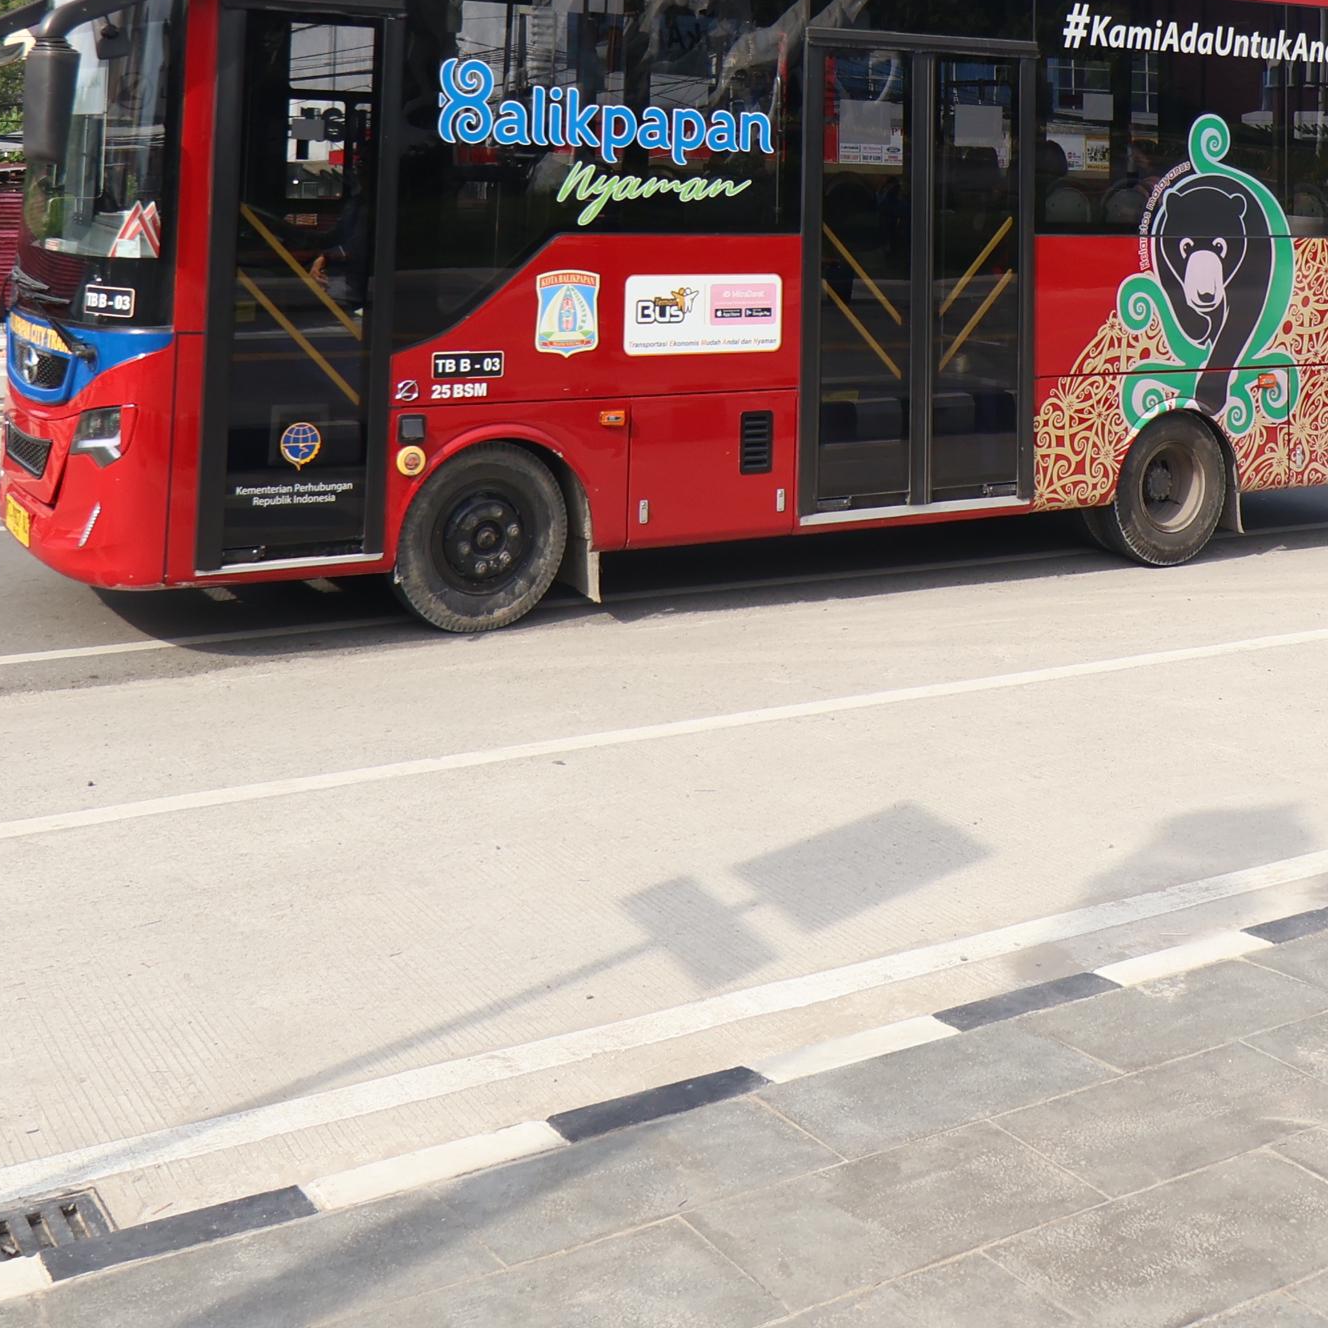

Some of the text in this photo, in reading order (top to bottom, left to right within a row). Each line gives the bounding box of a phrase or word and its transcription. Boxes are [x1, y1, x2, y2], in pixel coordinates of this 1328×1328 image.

[438, 58, 774, 165] Balikpapan
[556, 161, 752, 226] Nyaman
[114, 295, 130, 310] 03
[636, 300, 684, 324] Bus
[436, 359, 456, 372] TB
[460, 359, 470, 372] B
[483, 358, 500, 371] 03
[431, 382, 487, 399] 25 BSM
[236, 482, 353, 495] Kementerian Perhubungan
[252, 493, 336, 507] Republik Indonesia
